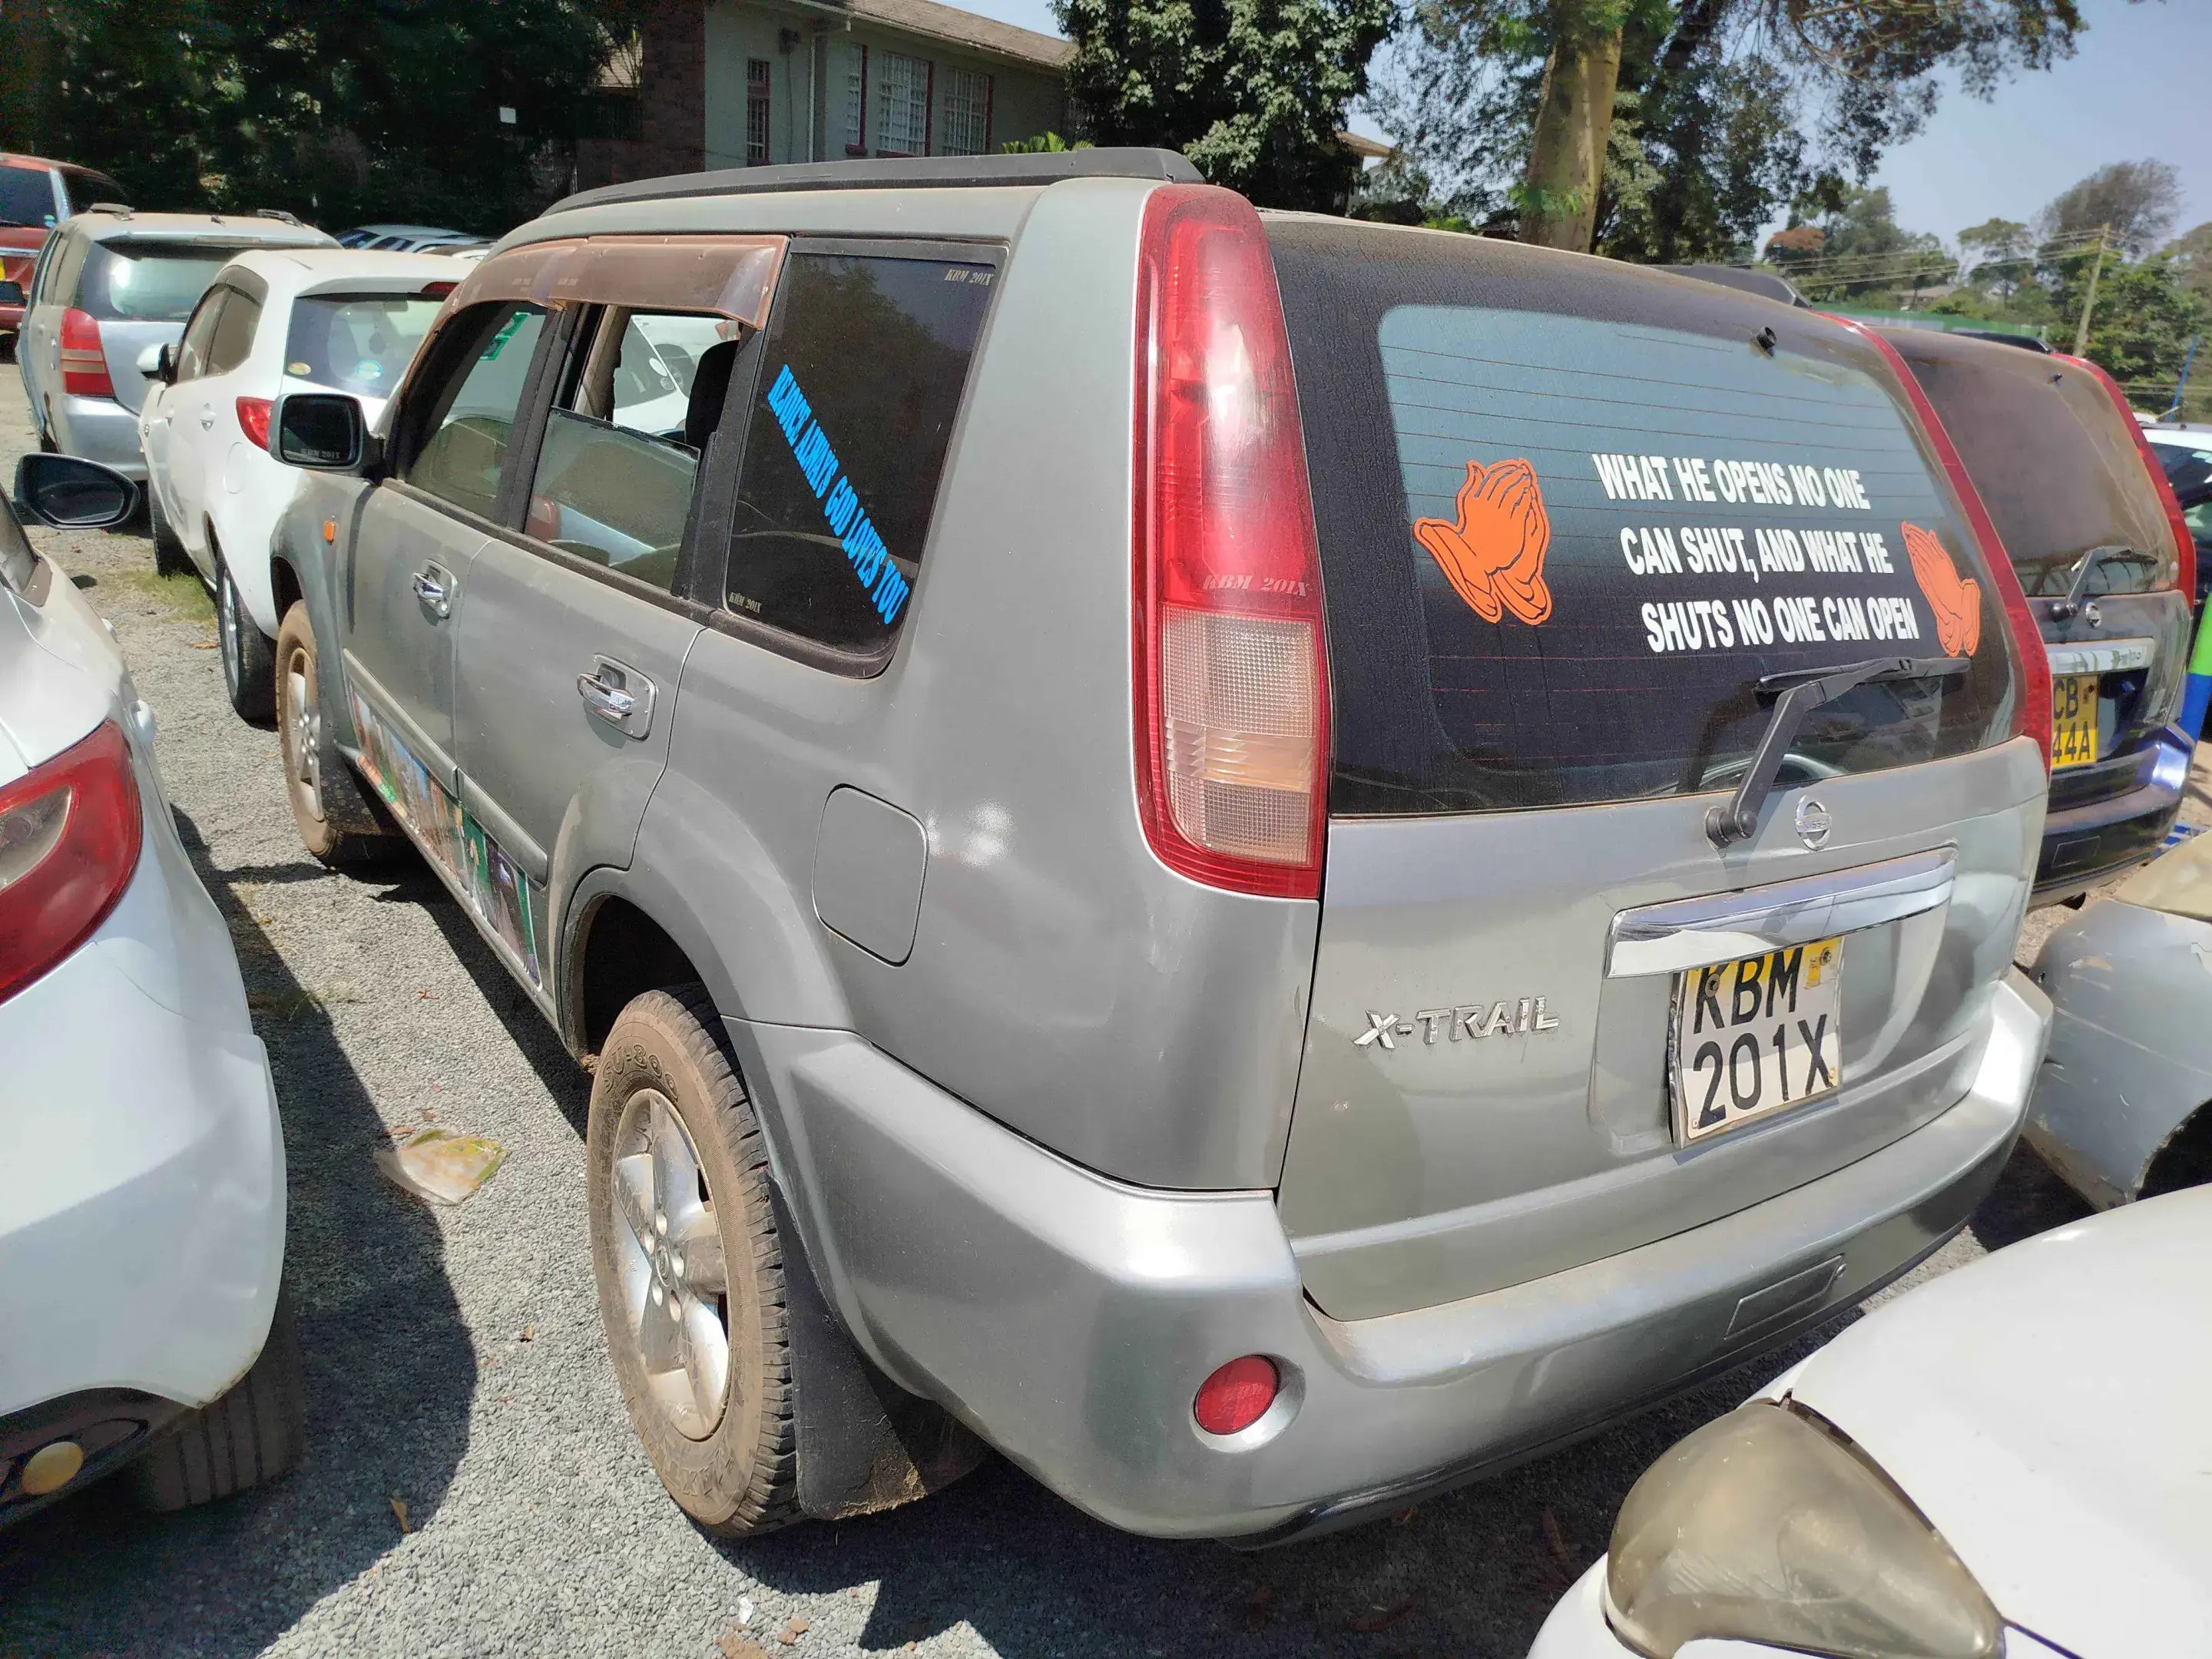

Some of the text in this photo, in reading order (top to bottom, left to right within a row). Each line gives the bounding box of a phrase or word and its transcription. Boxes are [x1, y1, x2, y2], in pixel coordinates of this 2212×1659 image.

[944, 269, 995, 286] KBM 201X
[767, 364, 909, 624] REJOICE ALWAYS GOD LOVES YOU
[1592, 454, 1871, 510] WHAT HE OPENS NO ONE
[1620, 527, 1894, 584] CAN SHUT, AND WHAT HE
[1202, 575, 1310, 596] KBM 201X
[1641, 598, 1919, 652] SHUTS NO ONE CAN OPEN
[1692, 947, 1803, 1034] KBM
[1353, 995, 1561, 1049] X-TRAIL
[604, 1044, 679, 1101] SU-800
[1692, 1014, 1835, 1130] 201X
